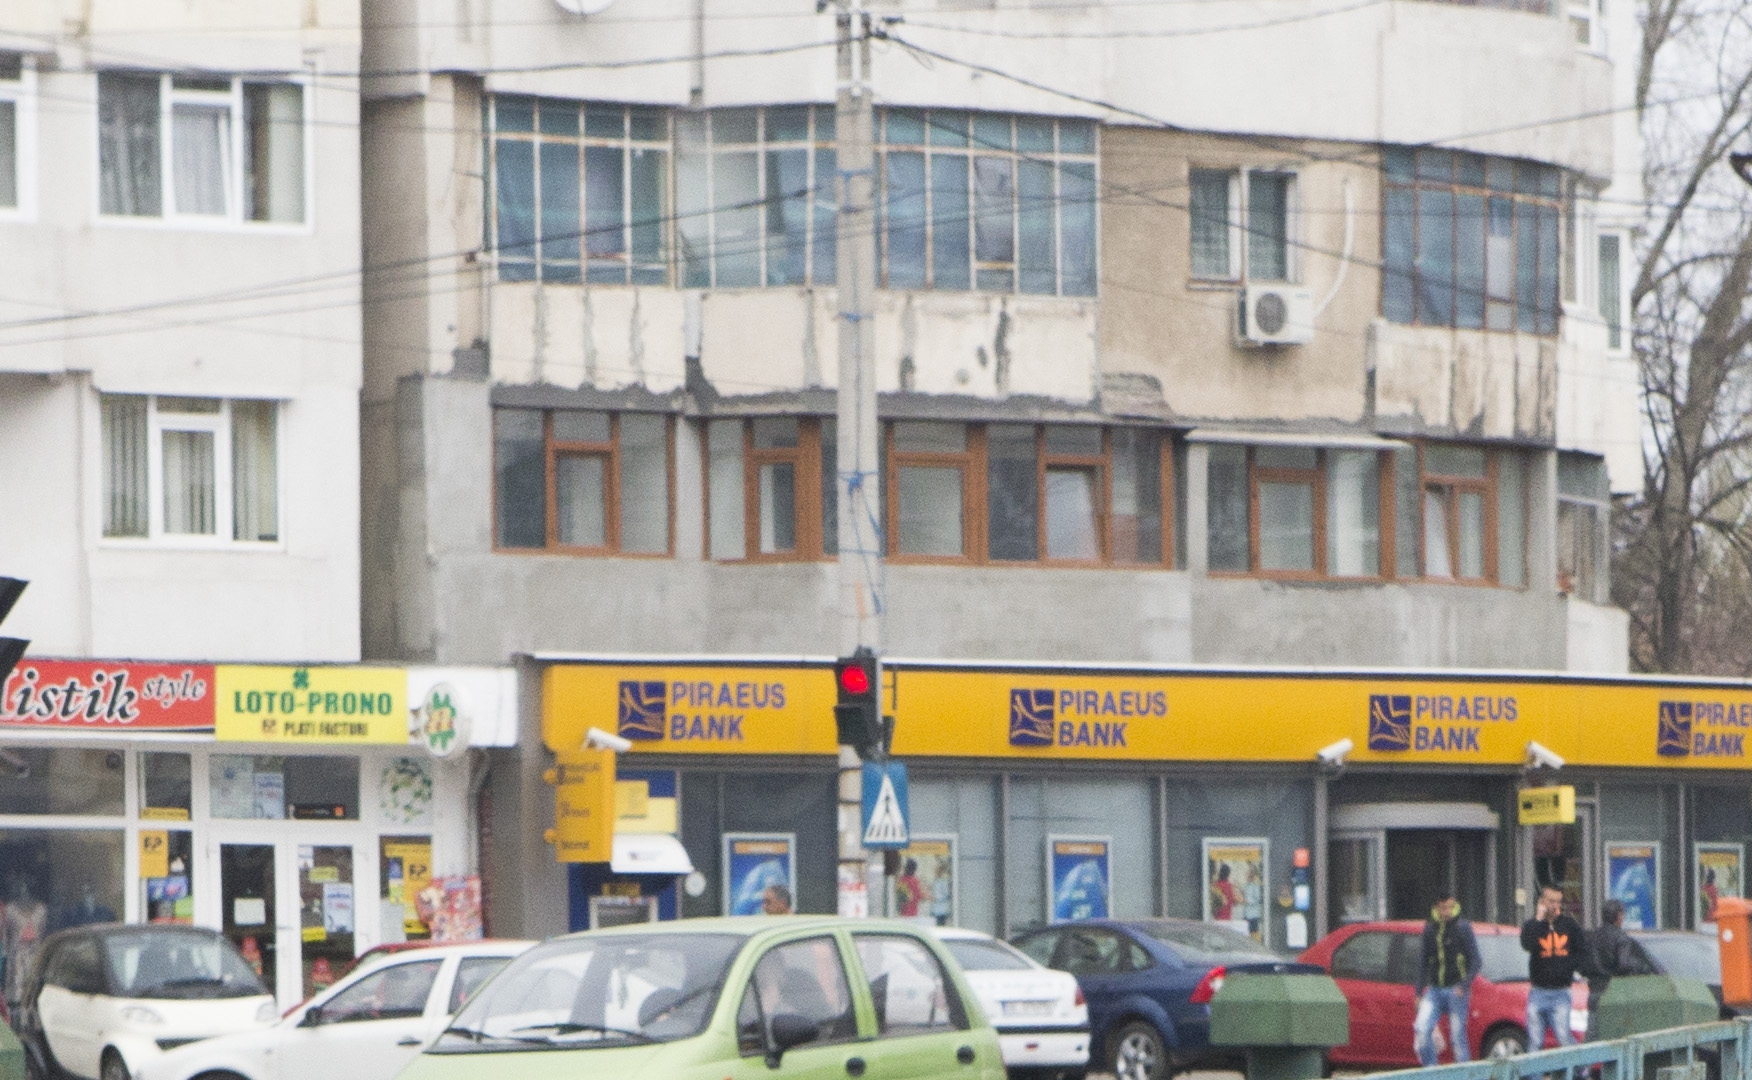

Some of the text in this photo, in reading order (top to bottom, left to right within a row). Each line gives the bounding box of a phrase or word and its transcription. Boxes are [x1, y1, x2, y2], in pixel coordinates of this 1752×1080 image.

[0, 668, 206, 723] istik style
[234, 690, 393, 717] LOTO-PRONO
[670, 681, 787, 710] PIRAEUS
[1059, 689, 1168, 717] PIRAEUS
[1415, 695, 1518, 721] PIRAEUS
[670, 714, 744, 741] BANK
[1058, 722, 1129, 747] BANK
[1415, 727, 1480, 751] BANK
[1692, 734, 1745, 758] BANK
